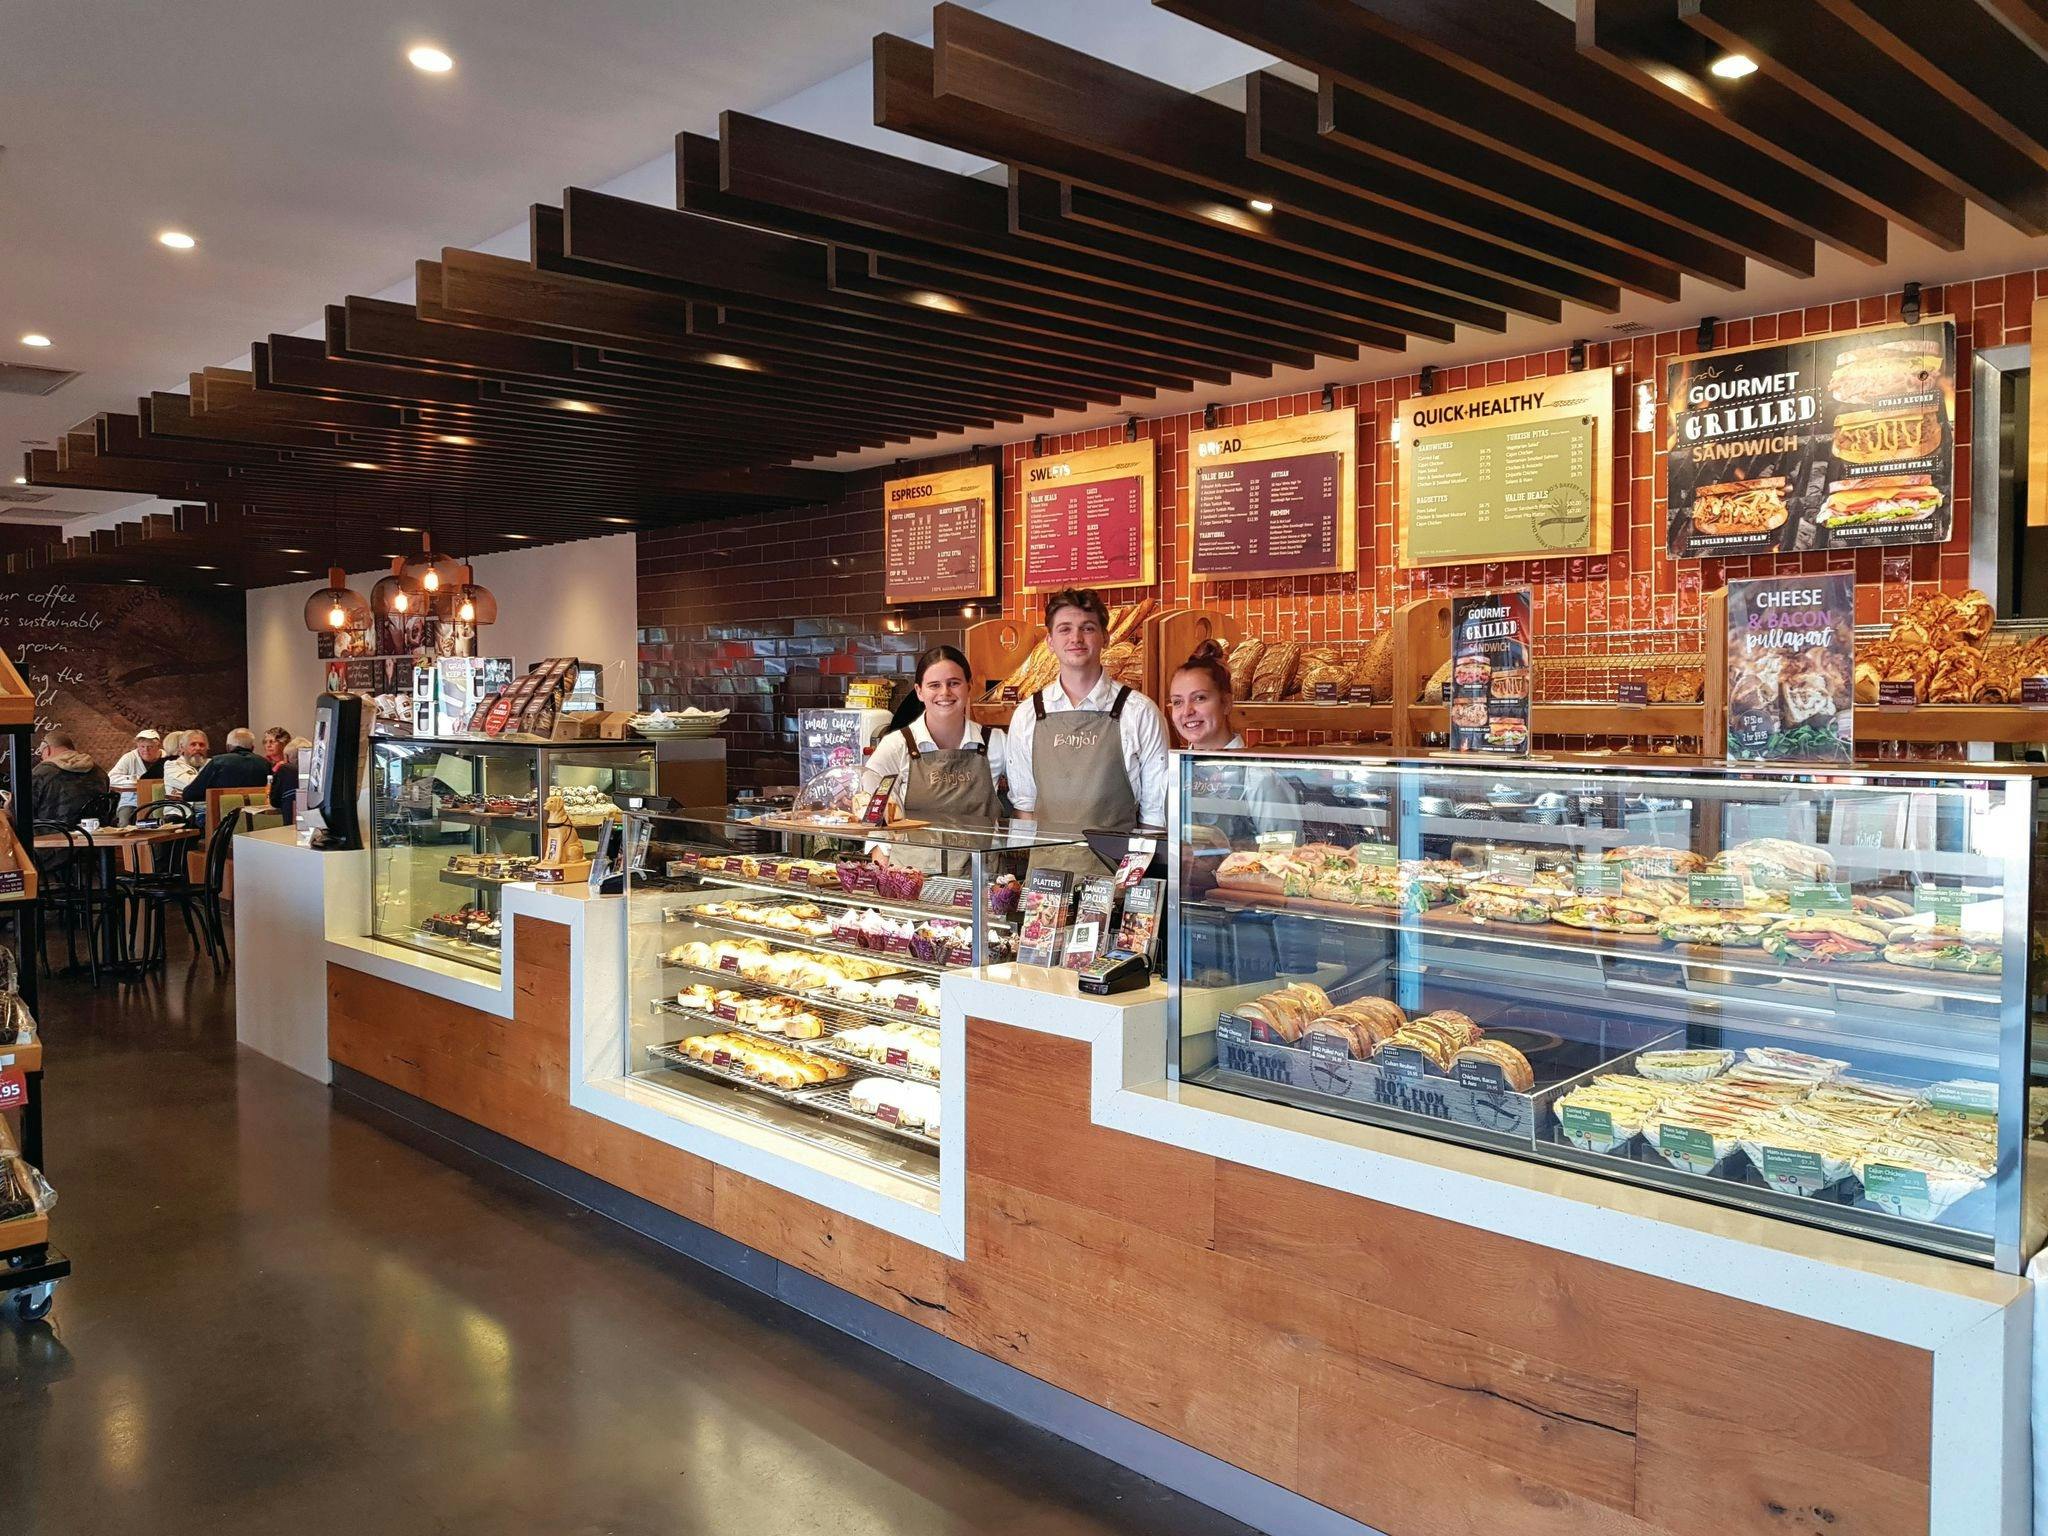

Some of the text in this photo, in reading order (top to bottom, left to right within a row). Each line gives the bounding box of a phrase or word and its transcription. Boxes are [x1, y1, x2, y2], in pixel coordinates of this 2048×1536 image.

[1689, 371, 1799, 404] GOURMET
[1685, 395, 1816, 440] GRILLED
[1507, 430, 1549, 441] TURKISH PITAS
[1419, 442, 1454, 451] SANDWICHES
[1693, 435, 1798, 463] SANDWICH
[1851, 461, 1932, 474] PHILLY CHEESE STEAK
[1218, 471, 1234, 479] DEALS
[892, 485, 932, 501] ESPRESSO
[1505, 491, 1549, 502] VALUE DEALS
[1417, 495, 1448, 504] BAGUETTES
[1902, 523, 1933, 531] AVOCADO
[27, 585, 78, 608] coffee
[1756, 589, 1823, 608] CHEESE
[1468, 606, 1511, 620] GOURMET
[18, 612, 103, 630] sustainably
[1749, 610, 1832, 629] & BACON
[1466, 620, 1517, 641] GRILLED
[1746, 627, 1835, 653] pullapart
[1469, 642, 1510, 653] SANDWICH
[57, 666, 85, 685] the
[1054, 730, 1098, 749] Banjo's
[1033, 878, 1061, 887] PLATTERS
[1085, 885, 1106, 893] BANJO'S
[1131, 887, 1151, 899] BREAD
[1081, 893, 1108, 903] VIP CLUB
[1228, 1046, 1255, 1062] HOT
[1384, 1059, 1399, 1067] Cuban
[1375, 1077, 1444, 1105] HOT FROM
[1375, 1092, 1449, 1120] THE GRILL
[1566, 1112, 1587, 1121] Sandwich
[1664, 1131, 1686, 1140] Sandwich
[1767, 1155, 1792, 1163] Sandwich
[1868, 1167, 1907, 1178] Cajun Chicken
[1868, 1173, 1895, 1182] Sandwich
